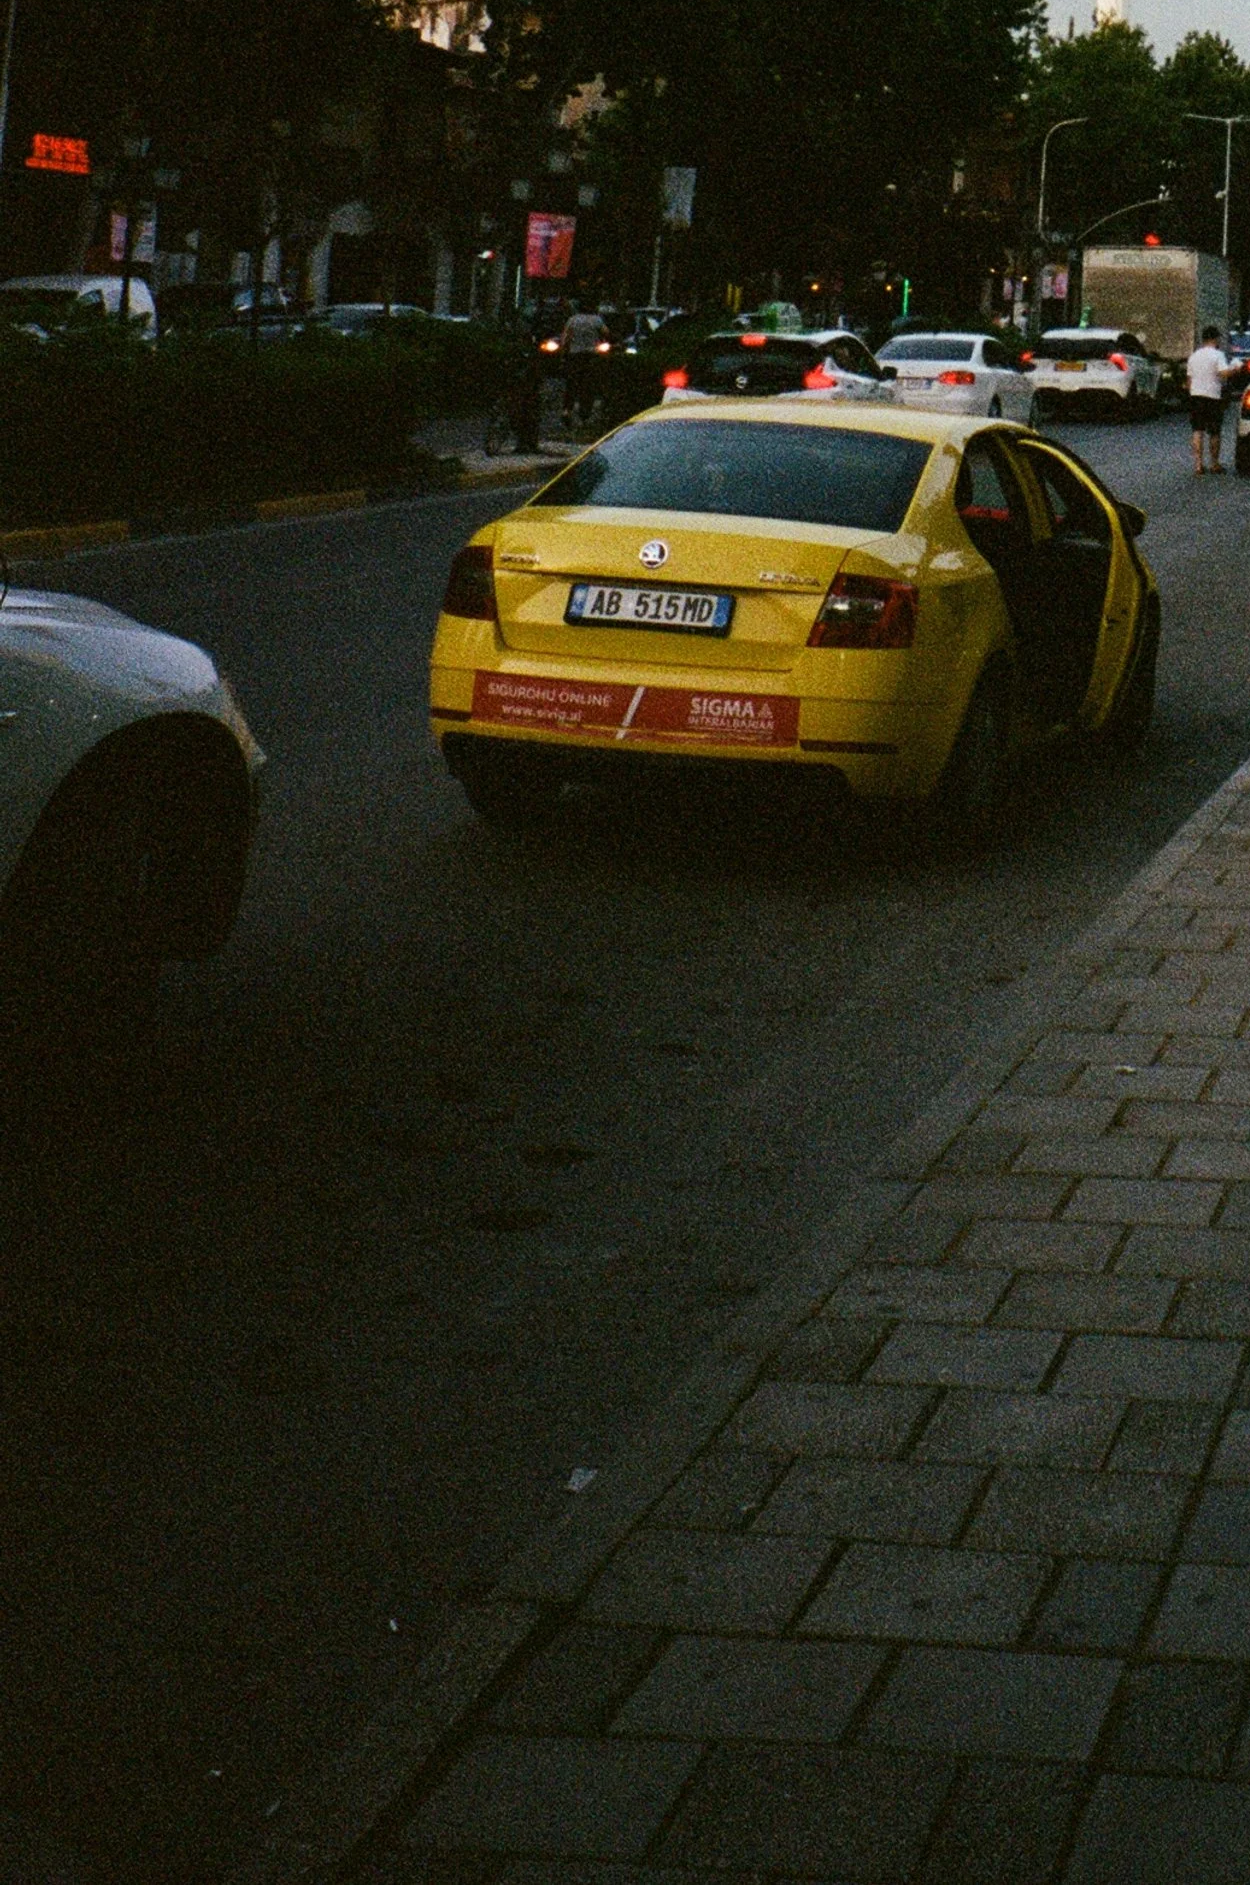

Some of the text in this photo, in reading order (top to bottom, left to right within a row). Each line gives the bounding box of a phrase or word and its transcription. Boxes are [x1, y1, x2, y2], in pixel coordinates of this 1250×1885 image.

[590, 589, 622, 616] AB
[558, 692, 612, 707] ONLINE
[690, 697, 754, 718] SIGMA
